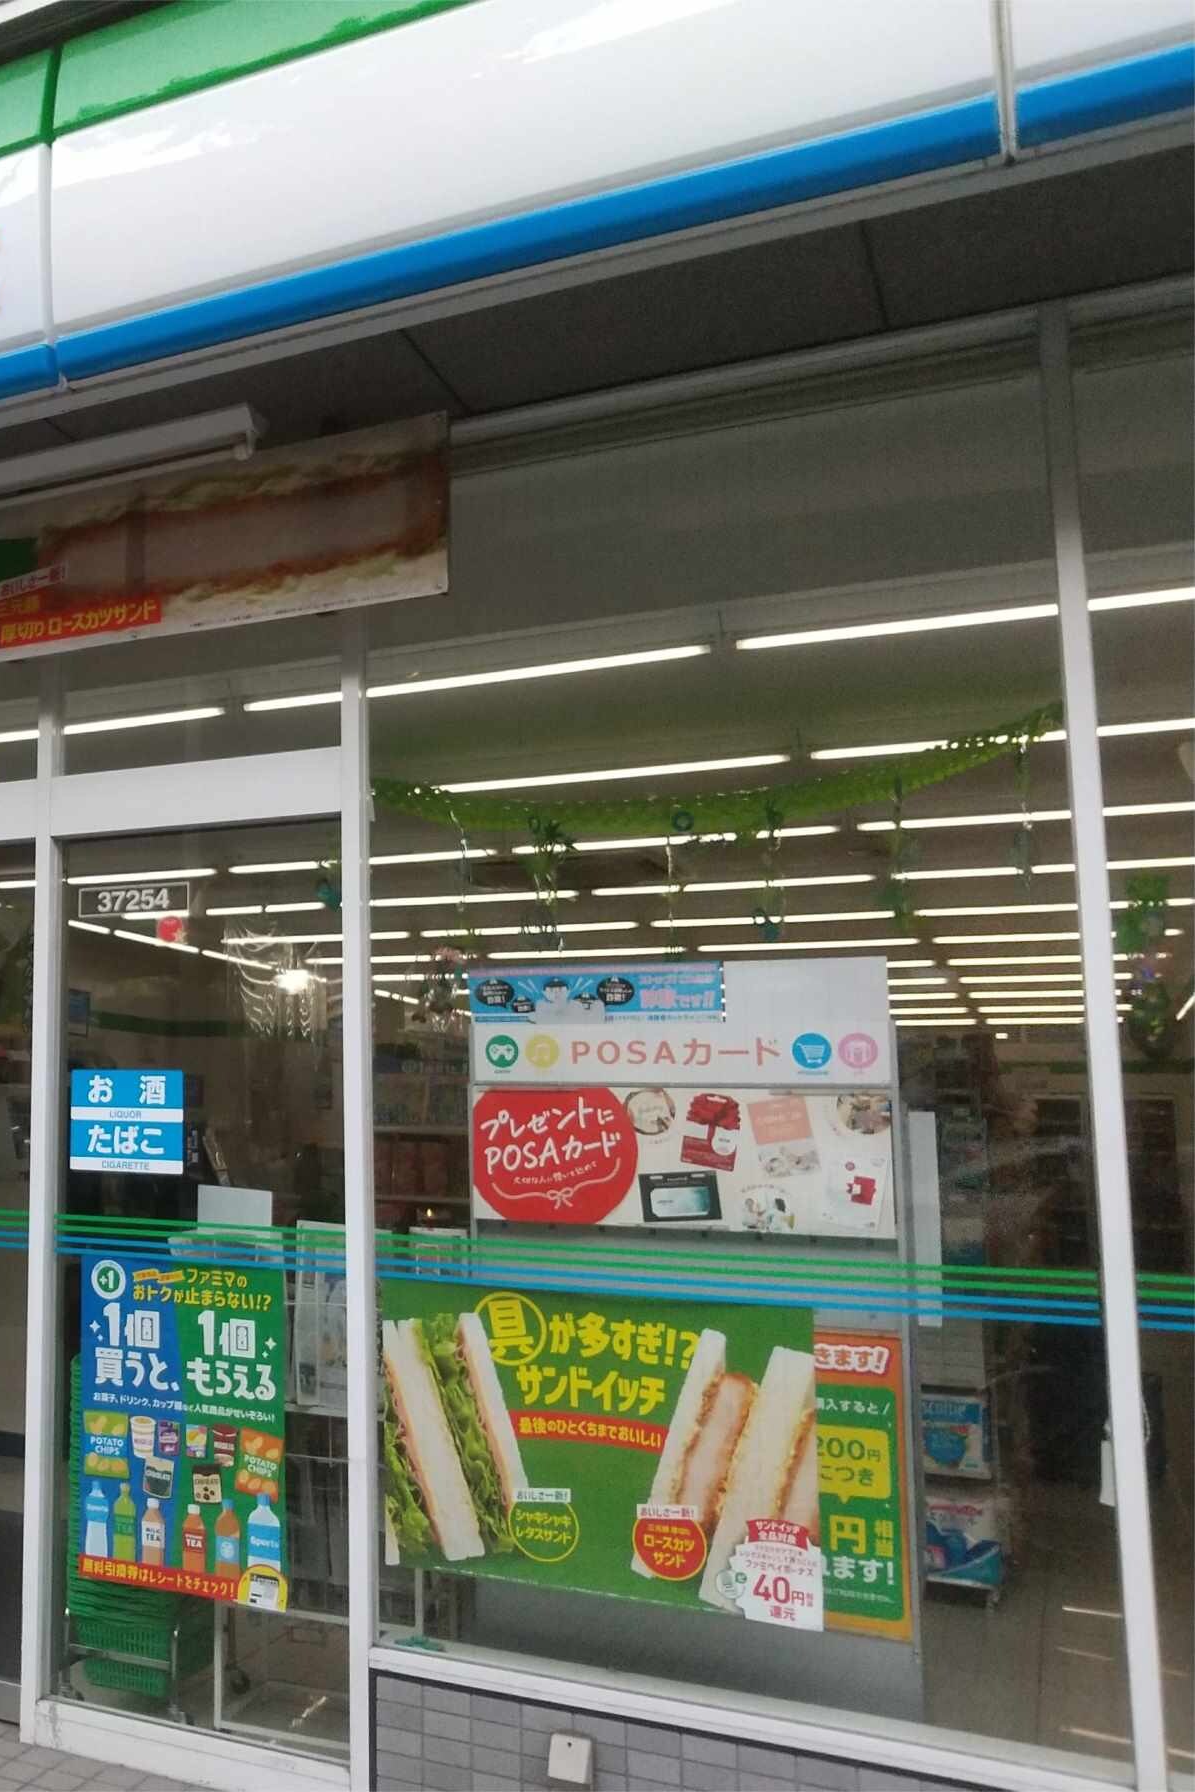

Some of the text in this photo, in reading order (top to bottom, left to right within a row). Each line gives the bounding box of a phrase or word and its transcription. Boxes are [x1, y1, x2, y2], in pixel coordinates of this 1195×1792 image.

[97, 888, 170, 913] 37254
[570, 1037, 782, 1067] POSAカード
[109, 1110, 142, 1119] LIQUOR
[480, 1096, 614, 1141] プレゼントに
[87, 1125, 165, 1155] たばこ
[485, 1131, 621, 1175] POSAカード
[101, 1160, 150, 1170] CIGARETTE
[187, 1268, 247, 1287] ファミマの
[103, 1302, 160, 1349] 1個
[198, 1310, 256, 1359] 1個
[186, 1357, 276, 1401] もらえる
[516, 1365, 666, 1416] サンドイッチ
[90, 1436, 124, 1447] POTATO
[518, 1416, 662, 1448] 最後のひとくちまでおいしい
[95, 1446, 121, 1456] CHIPS
[243, 1455, 277, 1472] POTATO
[247, 1464, 272, 1478] CHIPS
[516, 1509, 571, 1528] シャキシャキ
[146, 1533, 161, 1542] TEA
[186, 1539, 203, 1548] TEA
[250, 1535, 280, 1549] Sports
[516, 1527, 572, 1545] レタスサンド
[644, 1534, 695, 1553] ロースカツ
[653, 1551, 686, 1568] サンド
